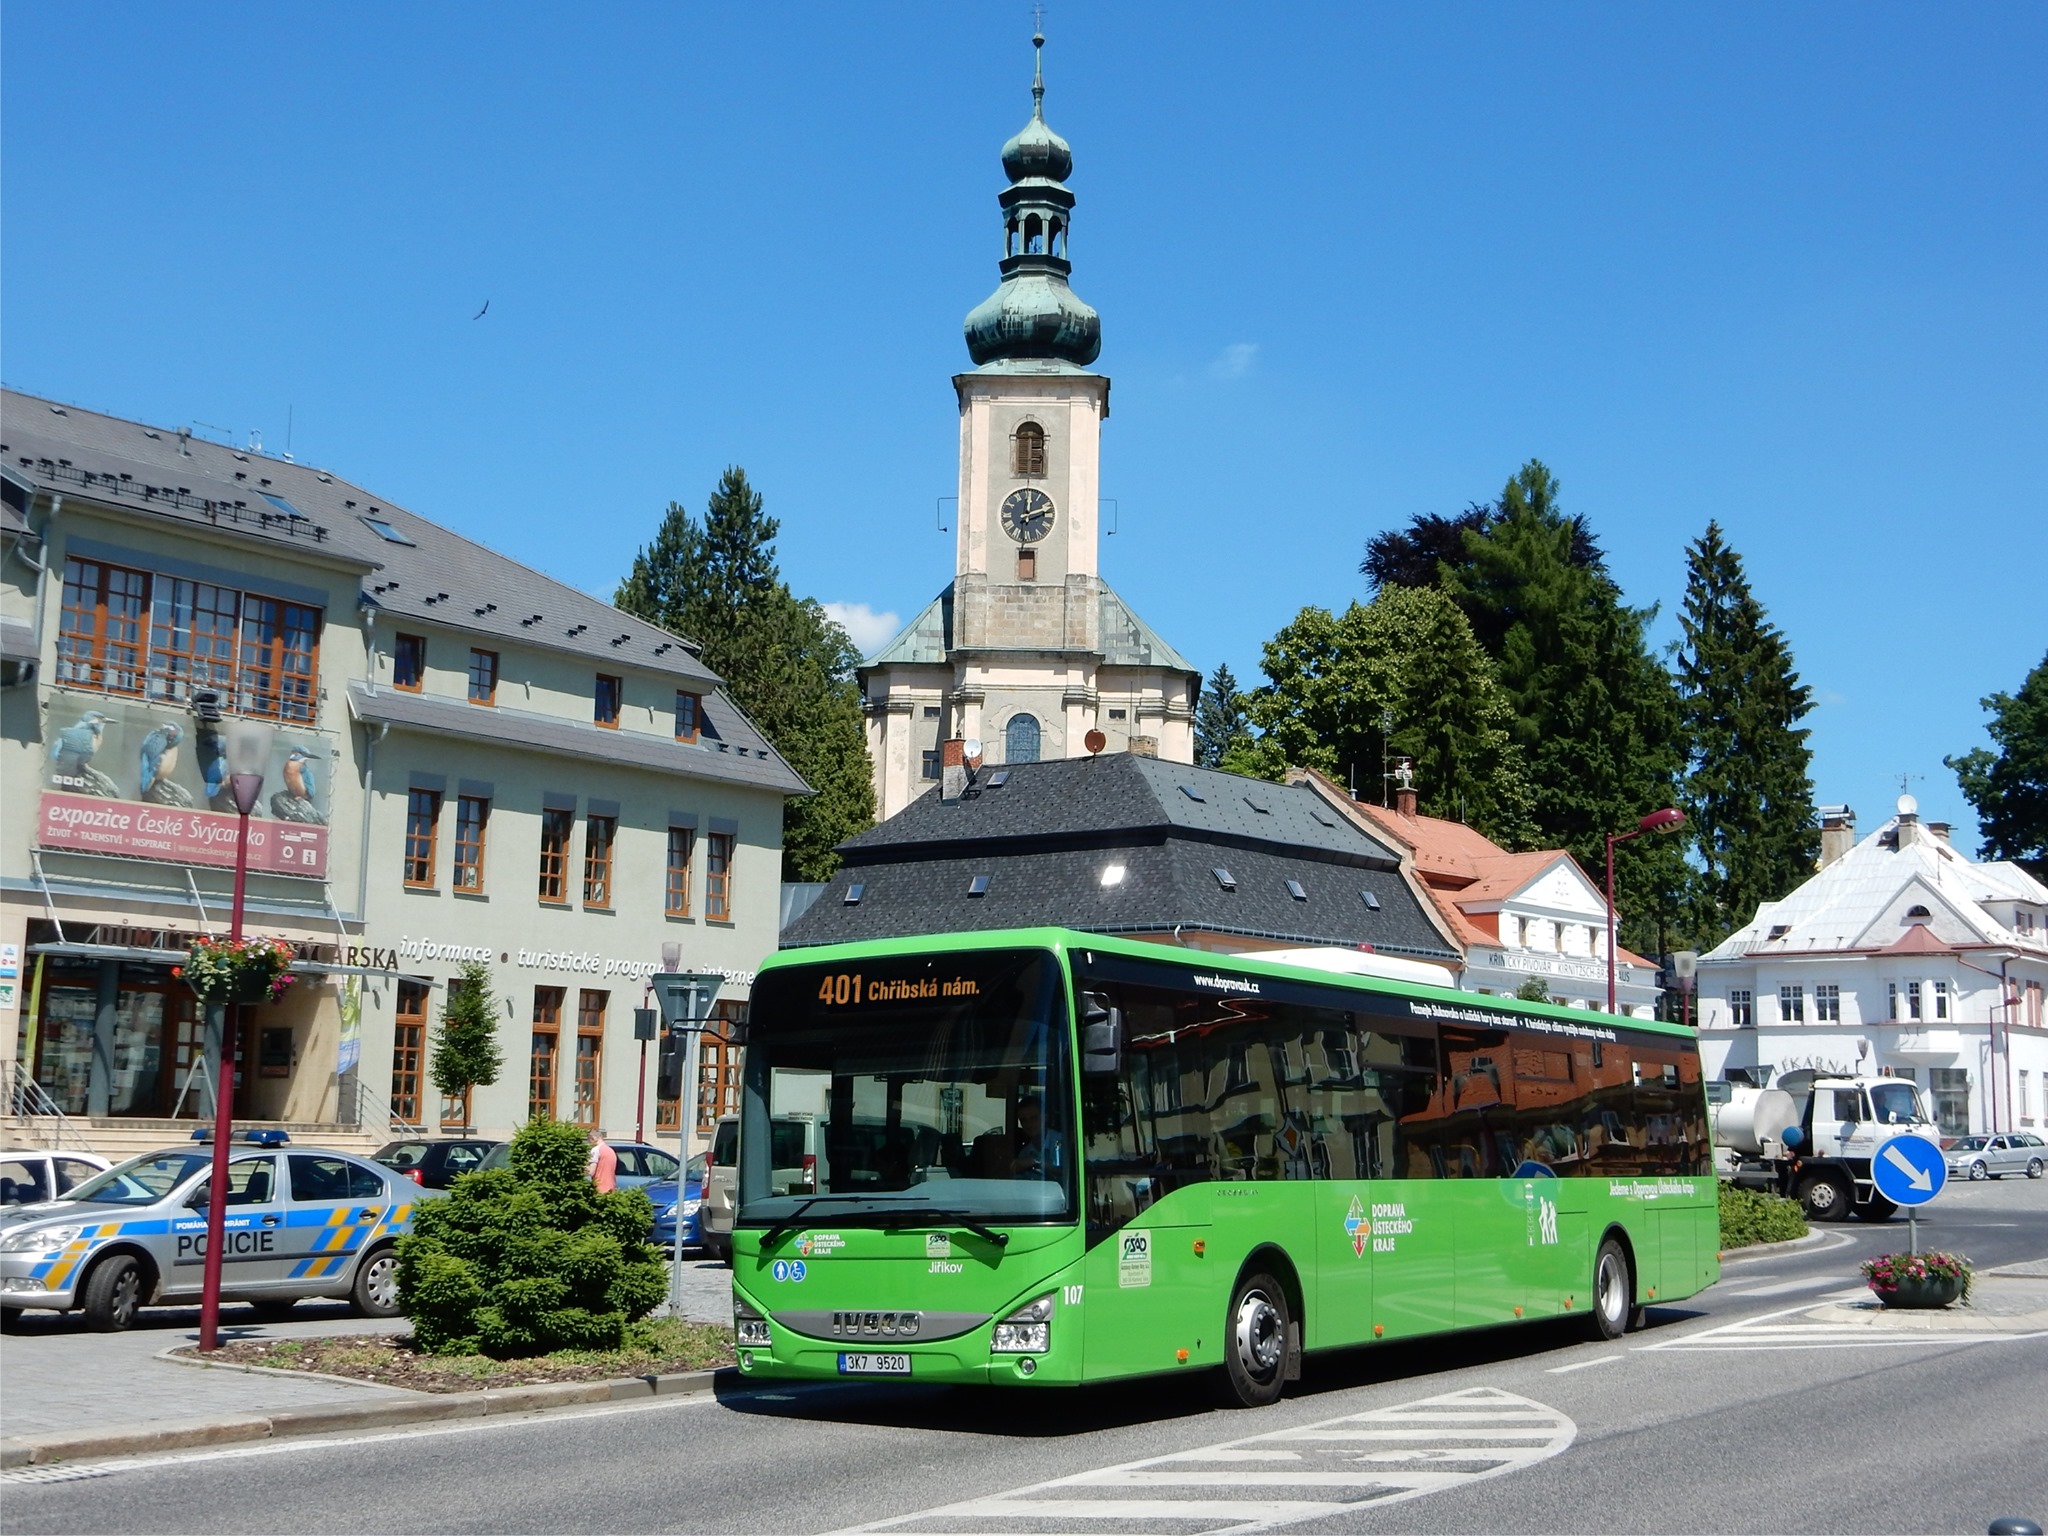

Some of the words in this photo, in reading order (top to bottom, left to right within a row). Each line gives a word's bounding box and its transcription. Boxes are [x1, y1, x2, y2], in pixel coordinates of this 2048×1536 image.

[48, 806, 131, 830] expozice
[137, 809, 183, 836] České
[187, 815, 265, 846] Švýcarko
[47, 826, 72, 838] ŽIVOT
[80, 831, 123, 844] TAJENSTVÍ
[132, 838, 172, 850] INSPIRACE
[99, 918, 153, 948] DŮM
[400, 935, 492, 964] informace
[518, 948, 600, 974] turistické
[1522, 958, 1552, 973] PIVOVAR
[818, 974, 862, 1005] 401
[868, 977, 938, 1001] Chřibská
[942, 976, 980, 997] nám.
[1193, 973, 1260, 993] www.dopravauk.cz
[1372, 1203, 1406, 1217] DOPRAVA
[176, 1220, 209, 1230] POMÁHA
[224, 1219, 251, 1228] HRÁNIT
[1372, 1217, 1412, 1235] ÚSTECKÉHO
[178, 1231, 274, 1257] POICIE
[1372, 1237, 1395, 1252] KRAJE
[928, 1261, 963, 1273] Jiříkov
[1063, 1285, 1083, 1305] 107
[833, 1312, 920, 1336] IVECO
[848, 1355, 868, 1370] 3K7
[876, 1356, 904, 1370] 9520
